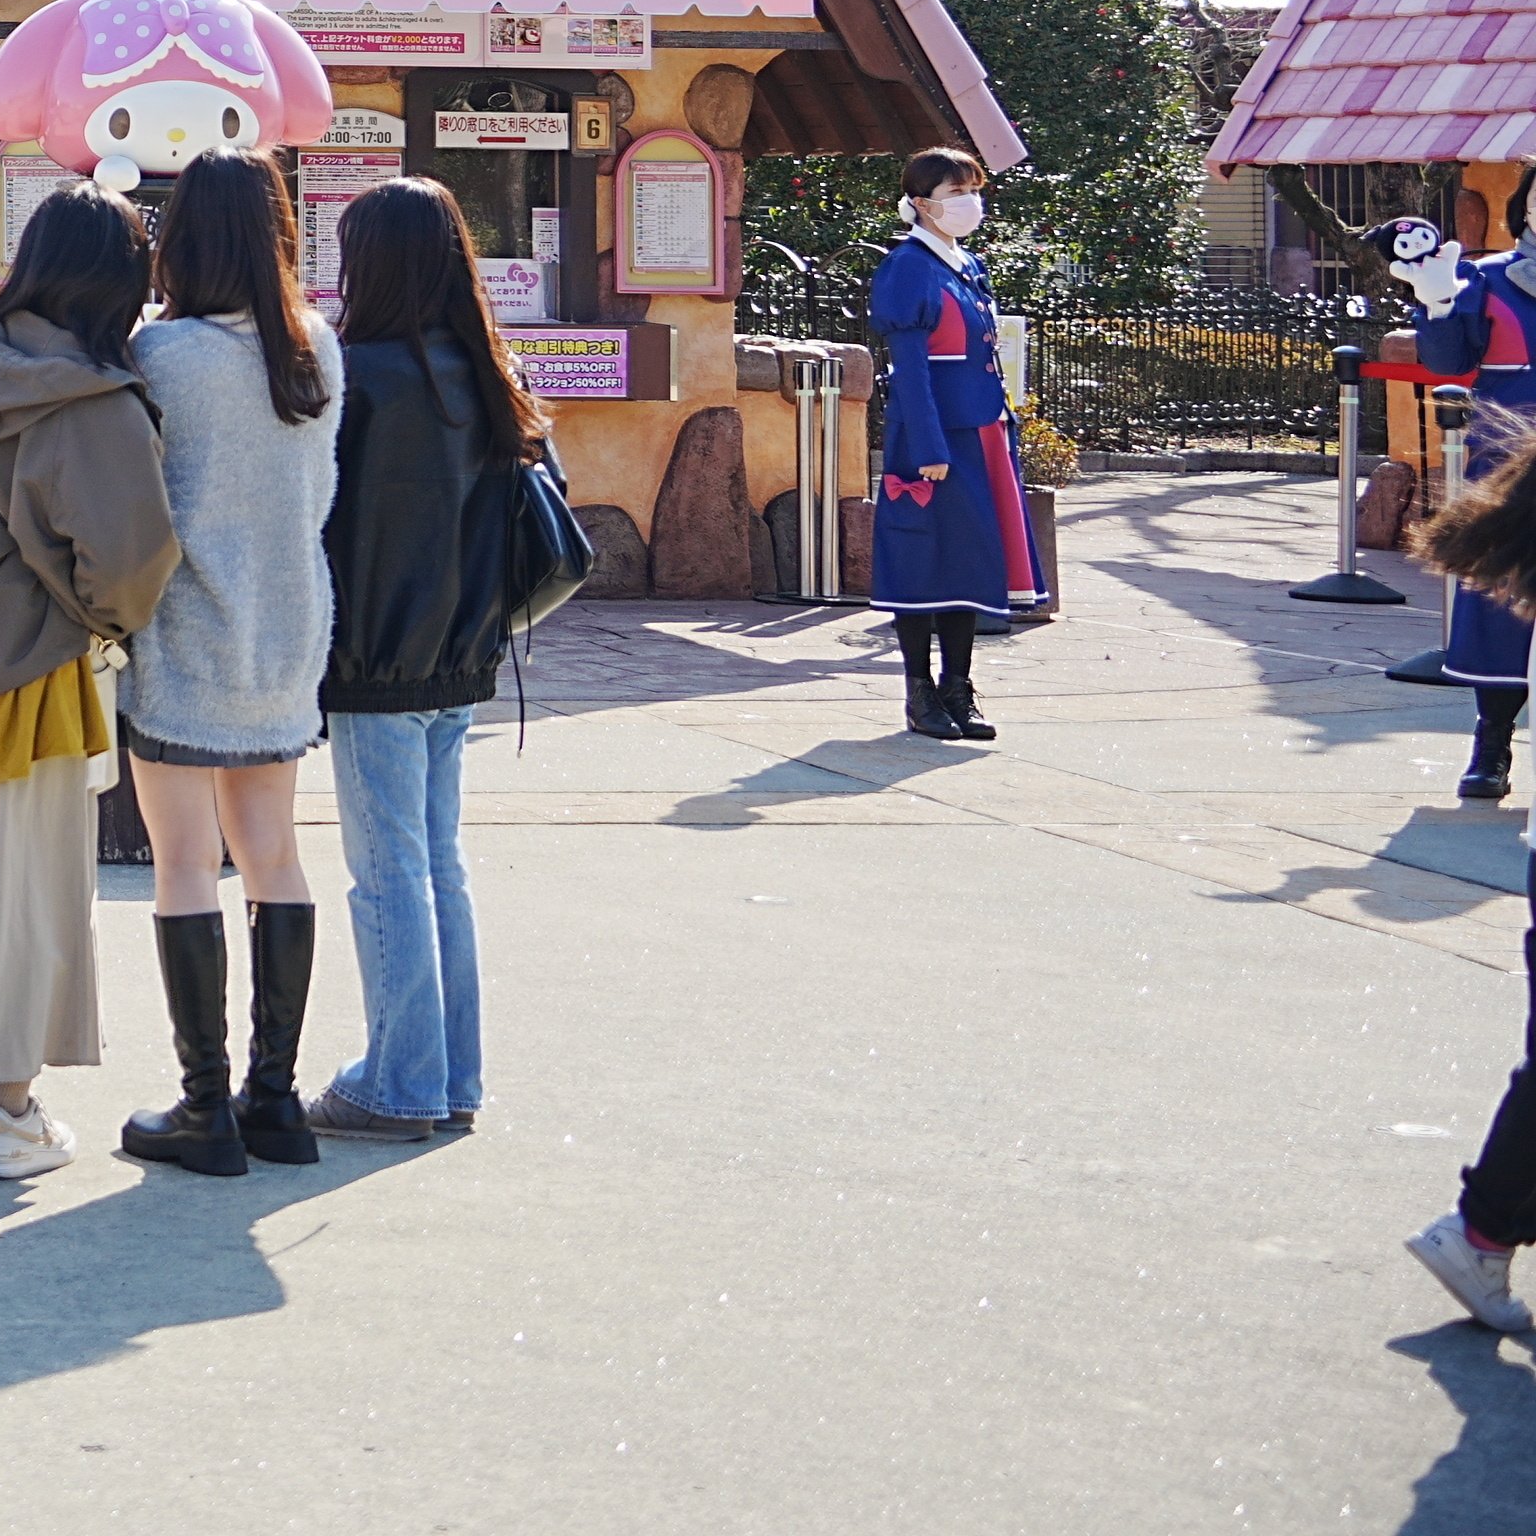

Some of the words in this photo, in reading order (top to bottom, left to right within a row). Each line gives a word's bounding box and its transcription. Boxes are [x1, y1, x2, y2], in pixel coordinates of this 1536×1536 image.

[439, 116, 567, 133] 隣りの窓口をご利用ください
[586, 119, 600, 139] 6
